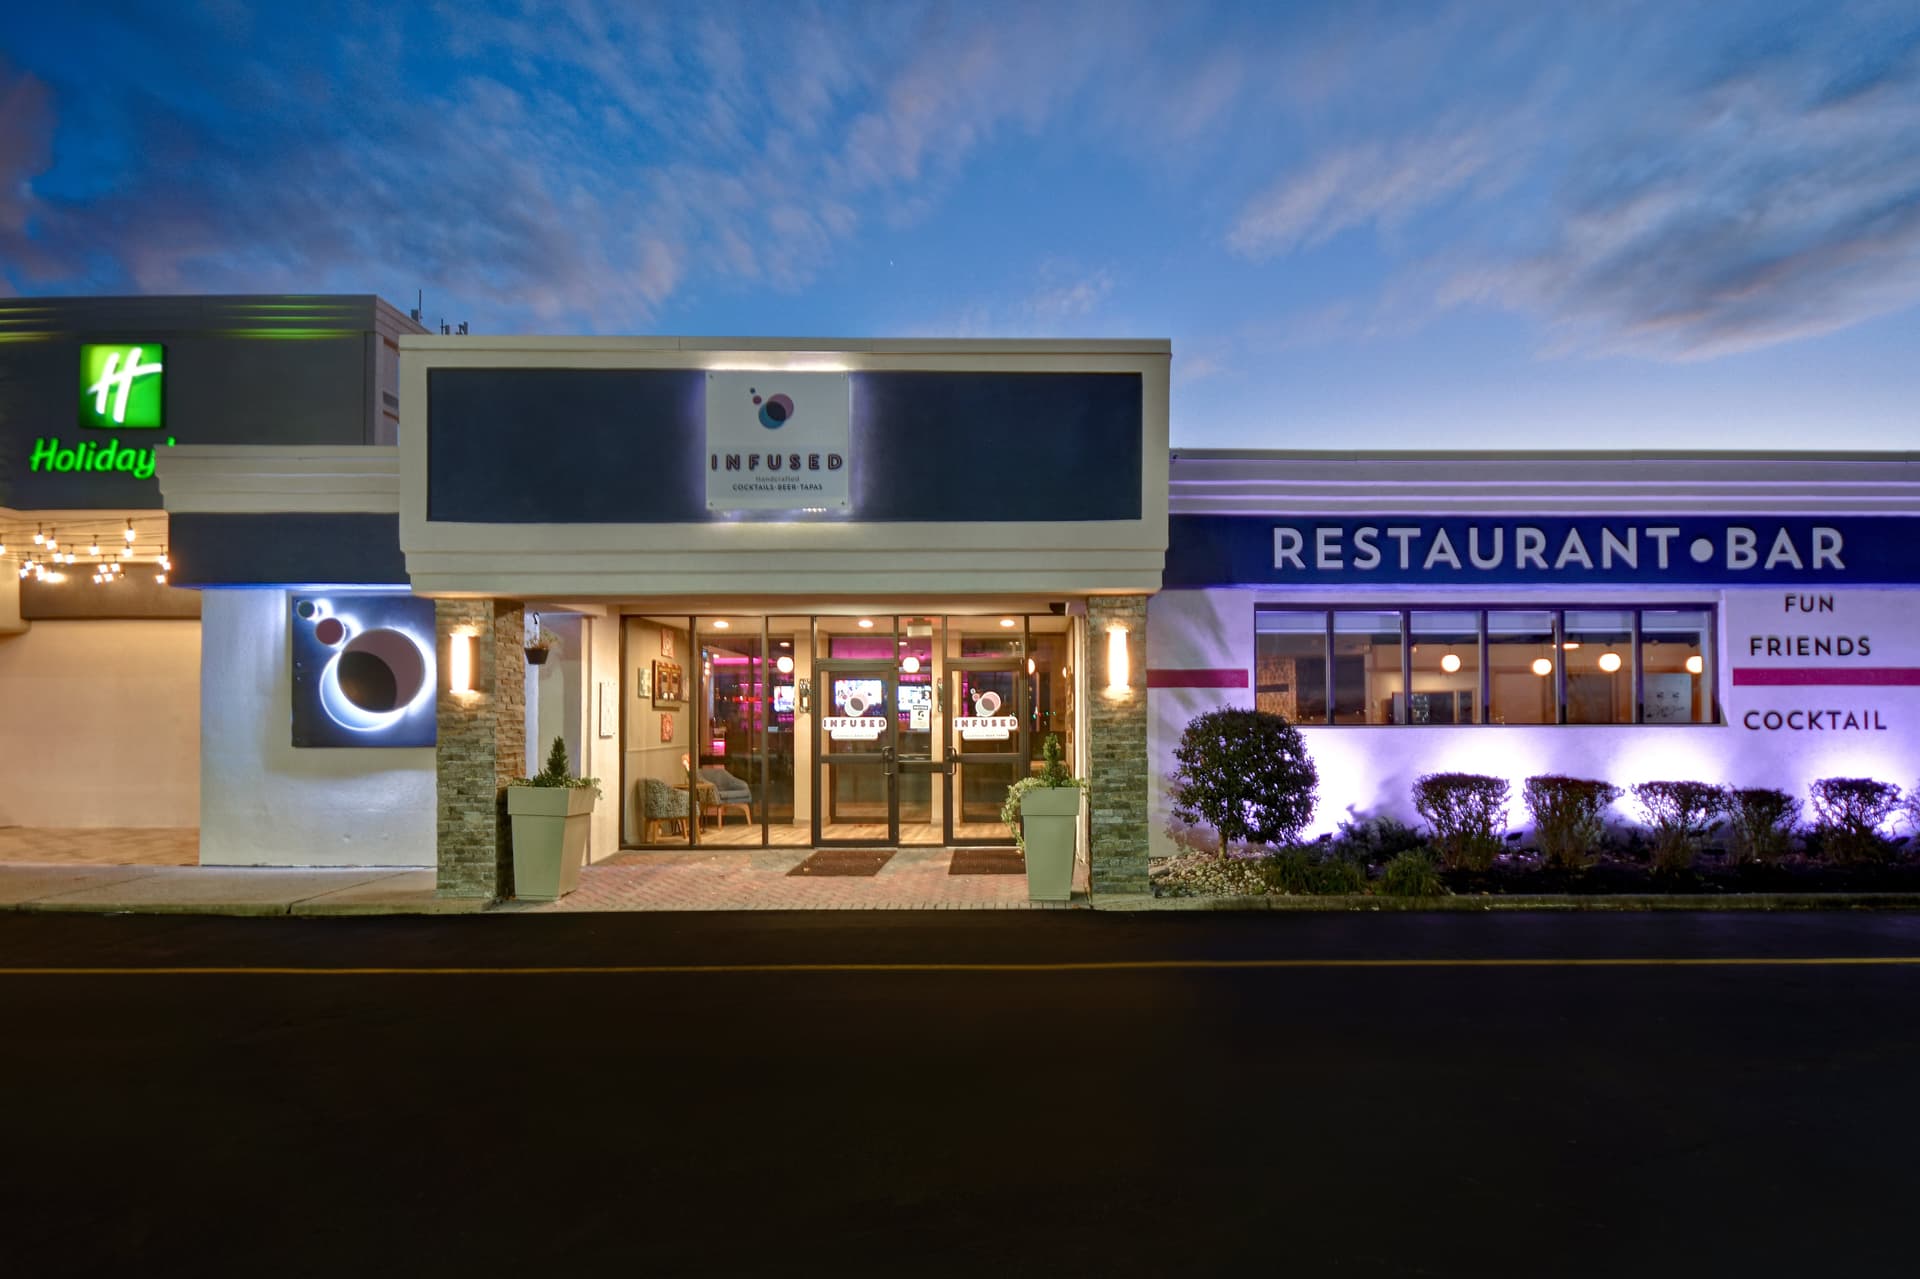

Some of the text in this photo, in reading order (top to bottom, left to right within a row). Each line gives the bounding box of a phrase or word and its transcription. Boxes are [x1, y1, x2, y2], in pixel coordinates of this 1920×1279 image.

[30, 437, 156, 479] Holiday
[711, 453, 843, 471] INFUSED
[1273, 527, 1846, 569] RESTAURANT BAR
[1784, 595, 1834, 613] FUN
[1750, 637, 1871, 656] FRIENDS
[823, 719, 886, 728] INFUSED
[954, 719, 1017, 728] INFUSED
[1743, 710, 1887, 730] COCKTAIL
